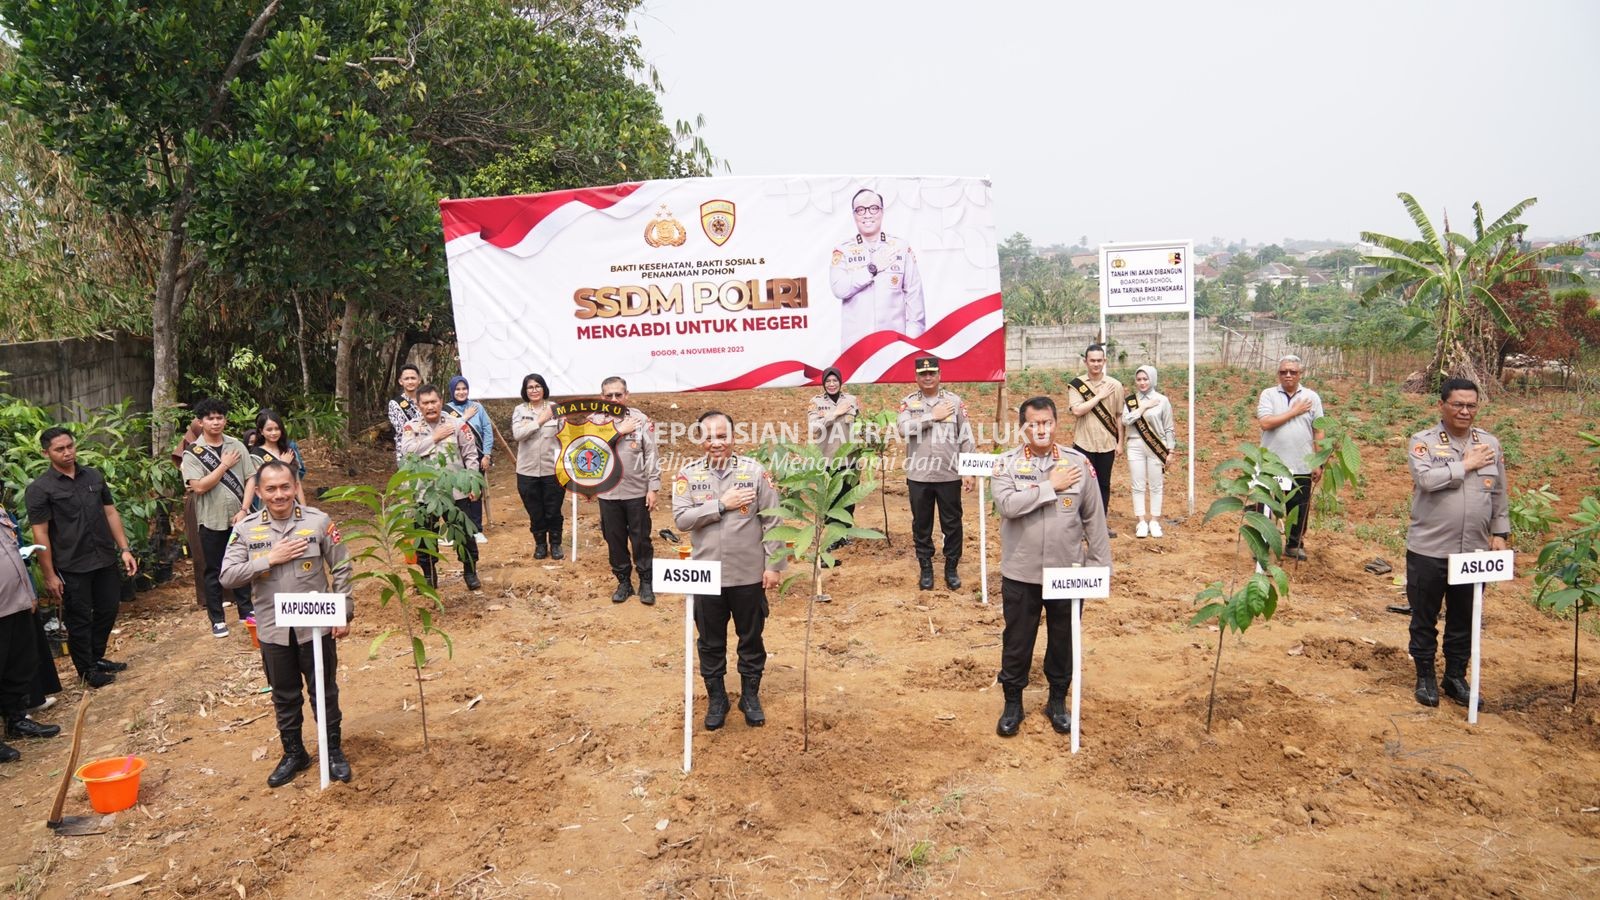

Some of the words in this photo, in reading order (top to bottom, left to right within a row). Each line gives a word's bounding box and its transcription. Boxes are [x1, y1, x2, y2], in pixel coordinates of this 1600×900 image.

[610, 264, 638, 273] BAKTI
[638, 261, 694, 272] KESEHATAN,
[696, 259, 723, 268] BAKTI
[725, 258, 756, 267] SOSIAL
[758, 257, 766, 265] &
[641, 268, 700, 279] PENANAMAN
[701, 267, 735, 276] POHON
[1154, 268, 1183, 276] DIBANGUN
[1122, 286, 1144, 294] TARUNA
[1144, 285, 1184, 293] BHAYANGKARA
[573, 284, 684, 320] SSDM
[693, 277, 809, 313] POLRI
[577, 322, 671, 340] MENGABDI
[676, 318, 738, 335] UNTUK
[743, 315, 808, 332] NEGERI
[650, 349, 679, 358] BOGOR,
[686, 347, 726, 356] NOVEMBER
[727, 346, 745, 354] 2023
[962, 459, 995, 470] KADIVKU
[248, 541, 272, 551] ASEP.H
[1460, 558, 1504, 575] ASLOG
[663, 568, 711, 583] ASSDM
[1051, 577, 1103, 590] KALEMDIKLAT
[281, 601, 336, 615] KAPUSDOKES
